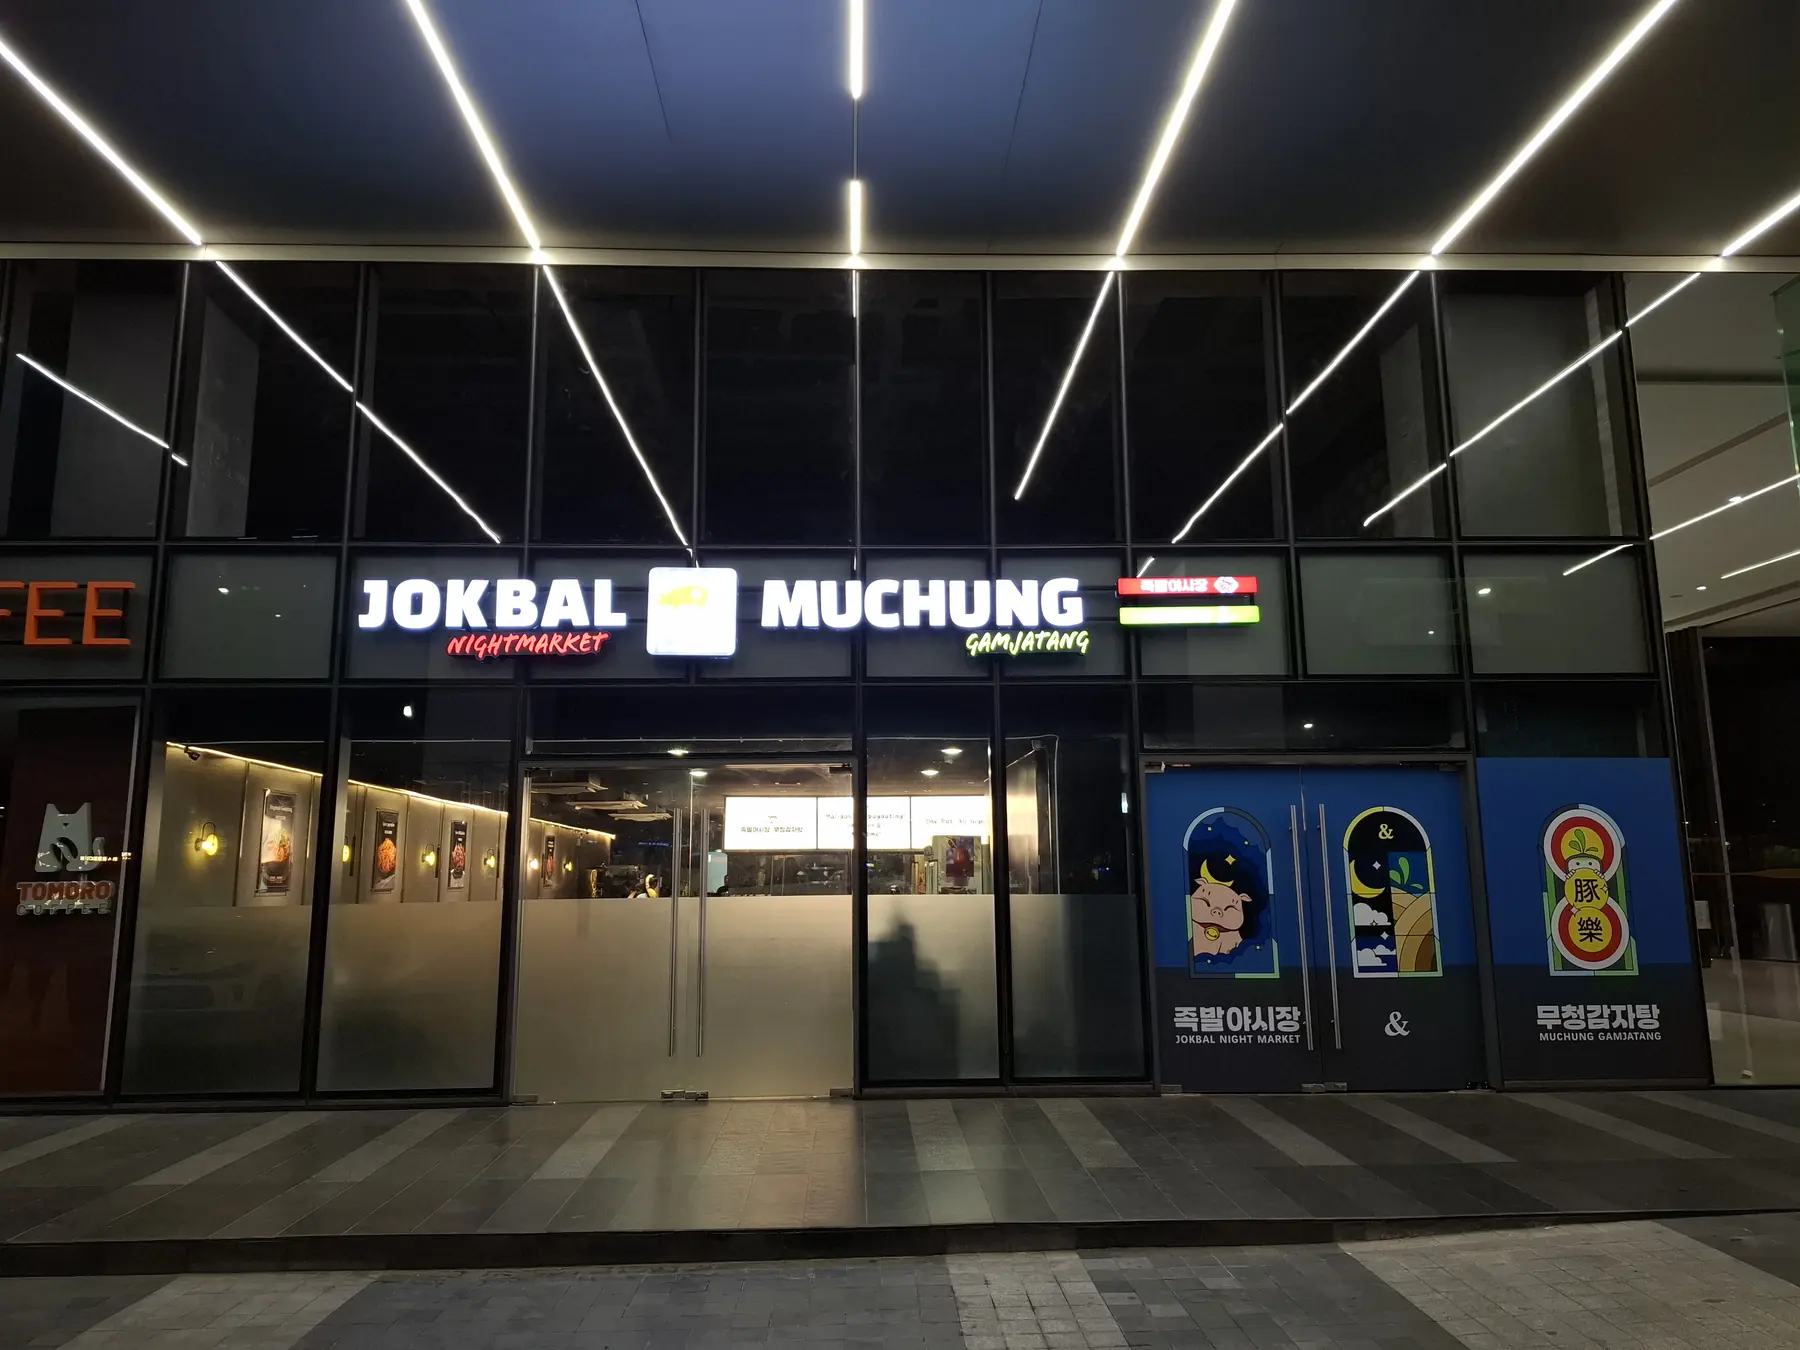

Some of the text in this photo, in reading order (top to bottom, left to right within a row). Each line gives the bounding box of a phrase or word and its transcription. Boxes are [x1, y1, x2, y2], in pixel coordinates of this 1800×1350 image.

[357, 578, 628, 630] JOKBAL
[760, 577, 1085, 630] MUCHUNG
[446, 631, 611, 660] NIGHTMARKET
[965, 630, 1089, 656] GAMJATANG
[17, 881, 114, 901] TOMORO
[17, 903, 111, 916] COFFEE
[1173, 1005, 1302, 1033] 족발야시장
[1536, 1003, 1661, 1031] 무청감자탕
[1175, 1034, 1301, 1044] JOKBAL NIGHT MARKET
[1539, 1031, 1662, 1042] MUCHUNG GAMJATANG
